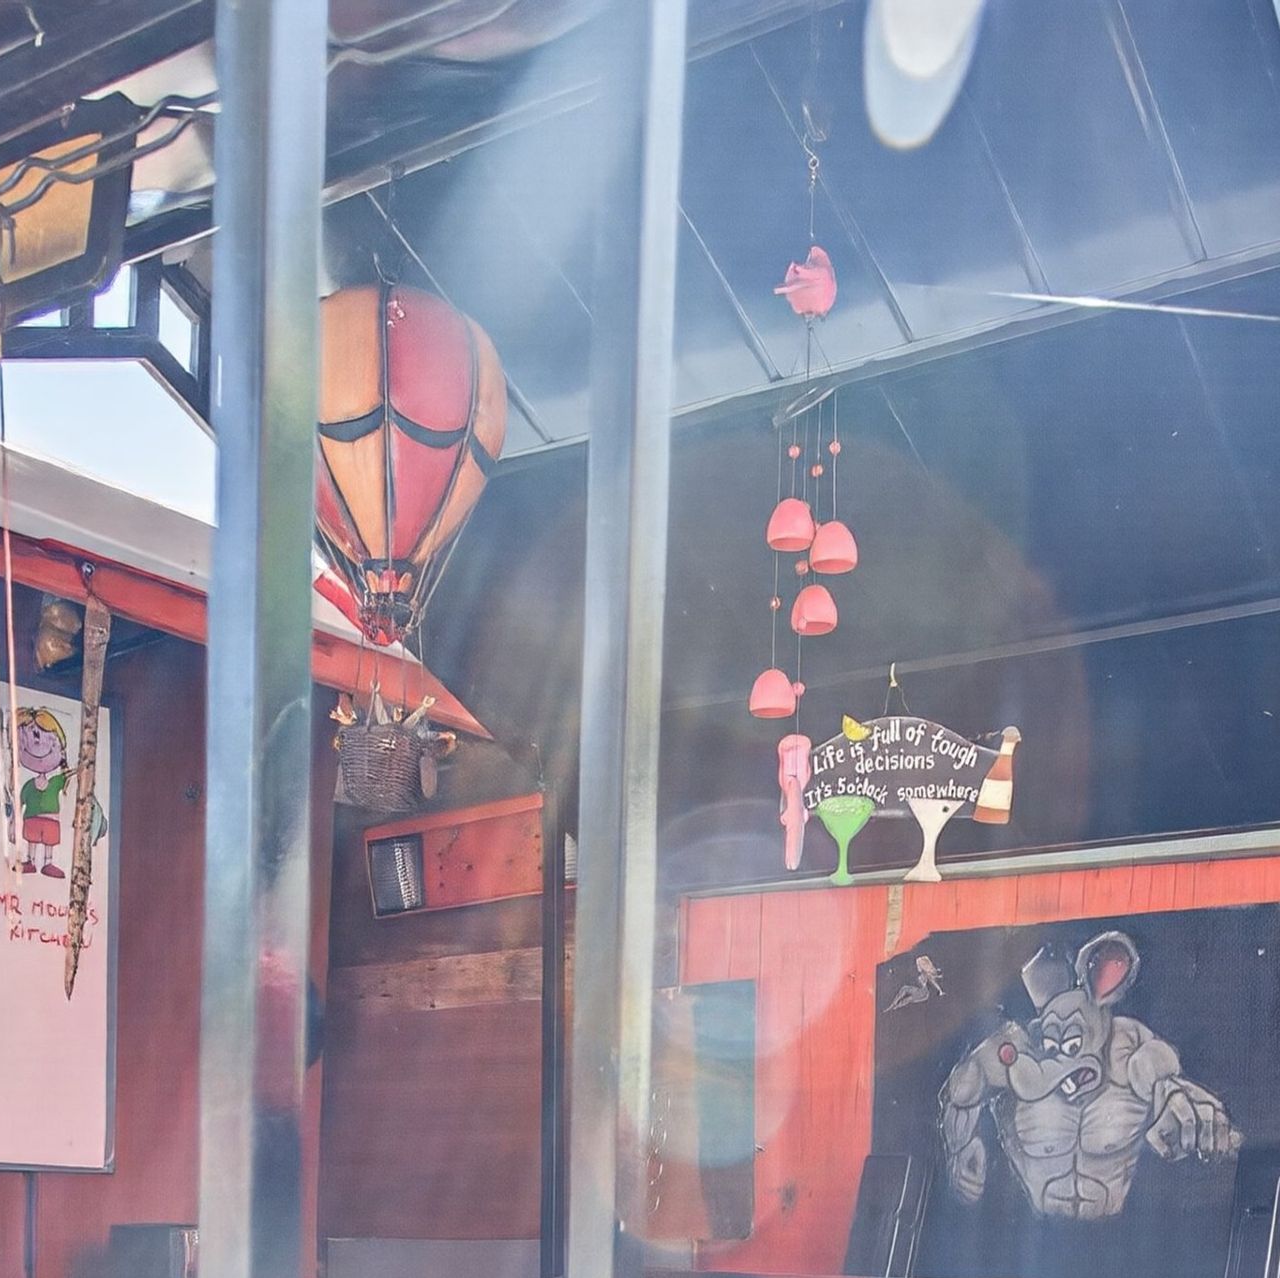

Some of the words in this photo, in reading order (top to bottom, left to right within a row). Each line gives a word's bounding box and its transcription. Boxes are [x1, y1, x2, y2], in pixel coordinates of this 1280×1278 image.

[813, 748, 845, 775] Life
[850, 741, 864, 759] is
[871, 719, 901, 751] full
[905, 723, 927, 746] of
[931, 731, 979, 771] tough
[854, 750, 936, 774] decisions
[804, 781, 832, 809] It's
[896, 779, 979, 803] somewhere
